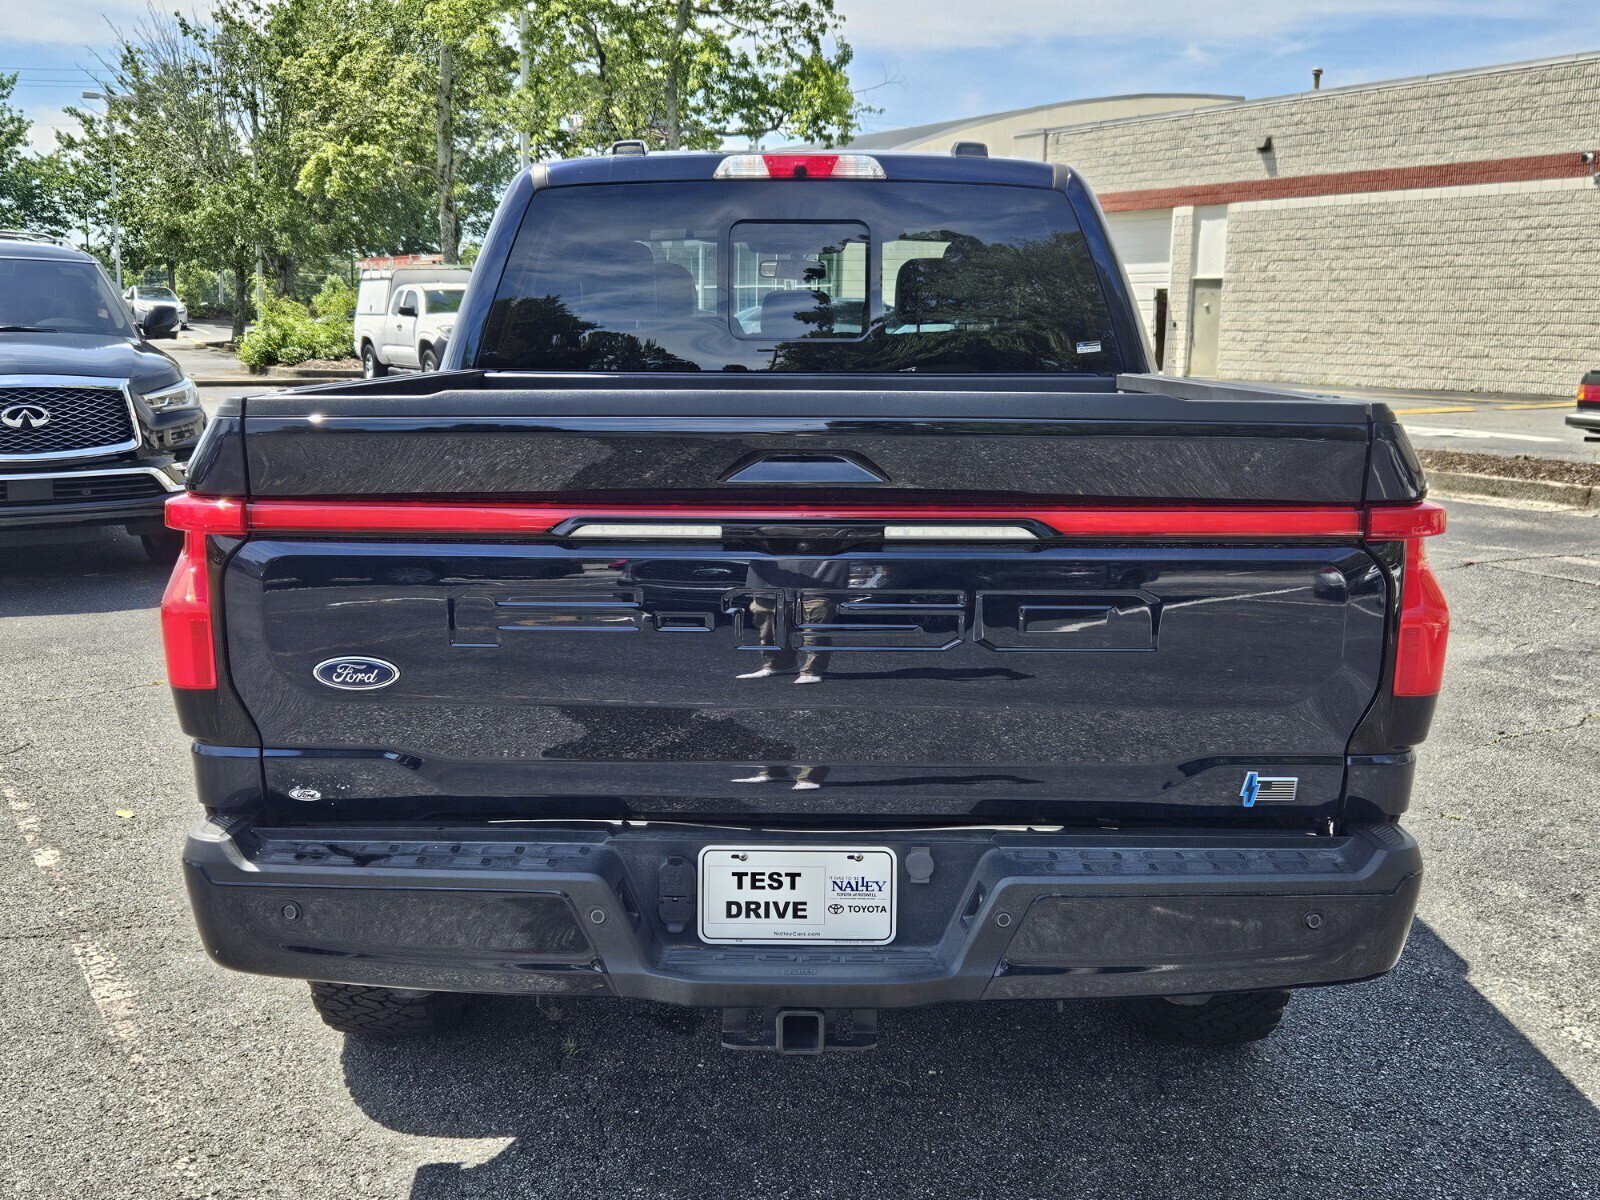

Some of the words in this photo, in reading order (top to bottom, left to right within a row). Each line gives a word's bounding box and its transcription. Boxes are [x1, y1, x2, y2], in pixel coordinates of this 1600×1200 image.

[332, 663, 379, 683] Ford
[731, 871, 802, 891] TEST
[831, 876, 887, 892] NALLEY
[725, 900, 808, 919] DRIVE
[848, 905, 887, 913] TOYOTA
